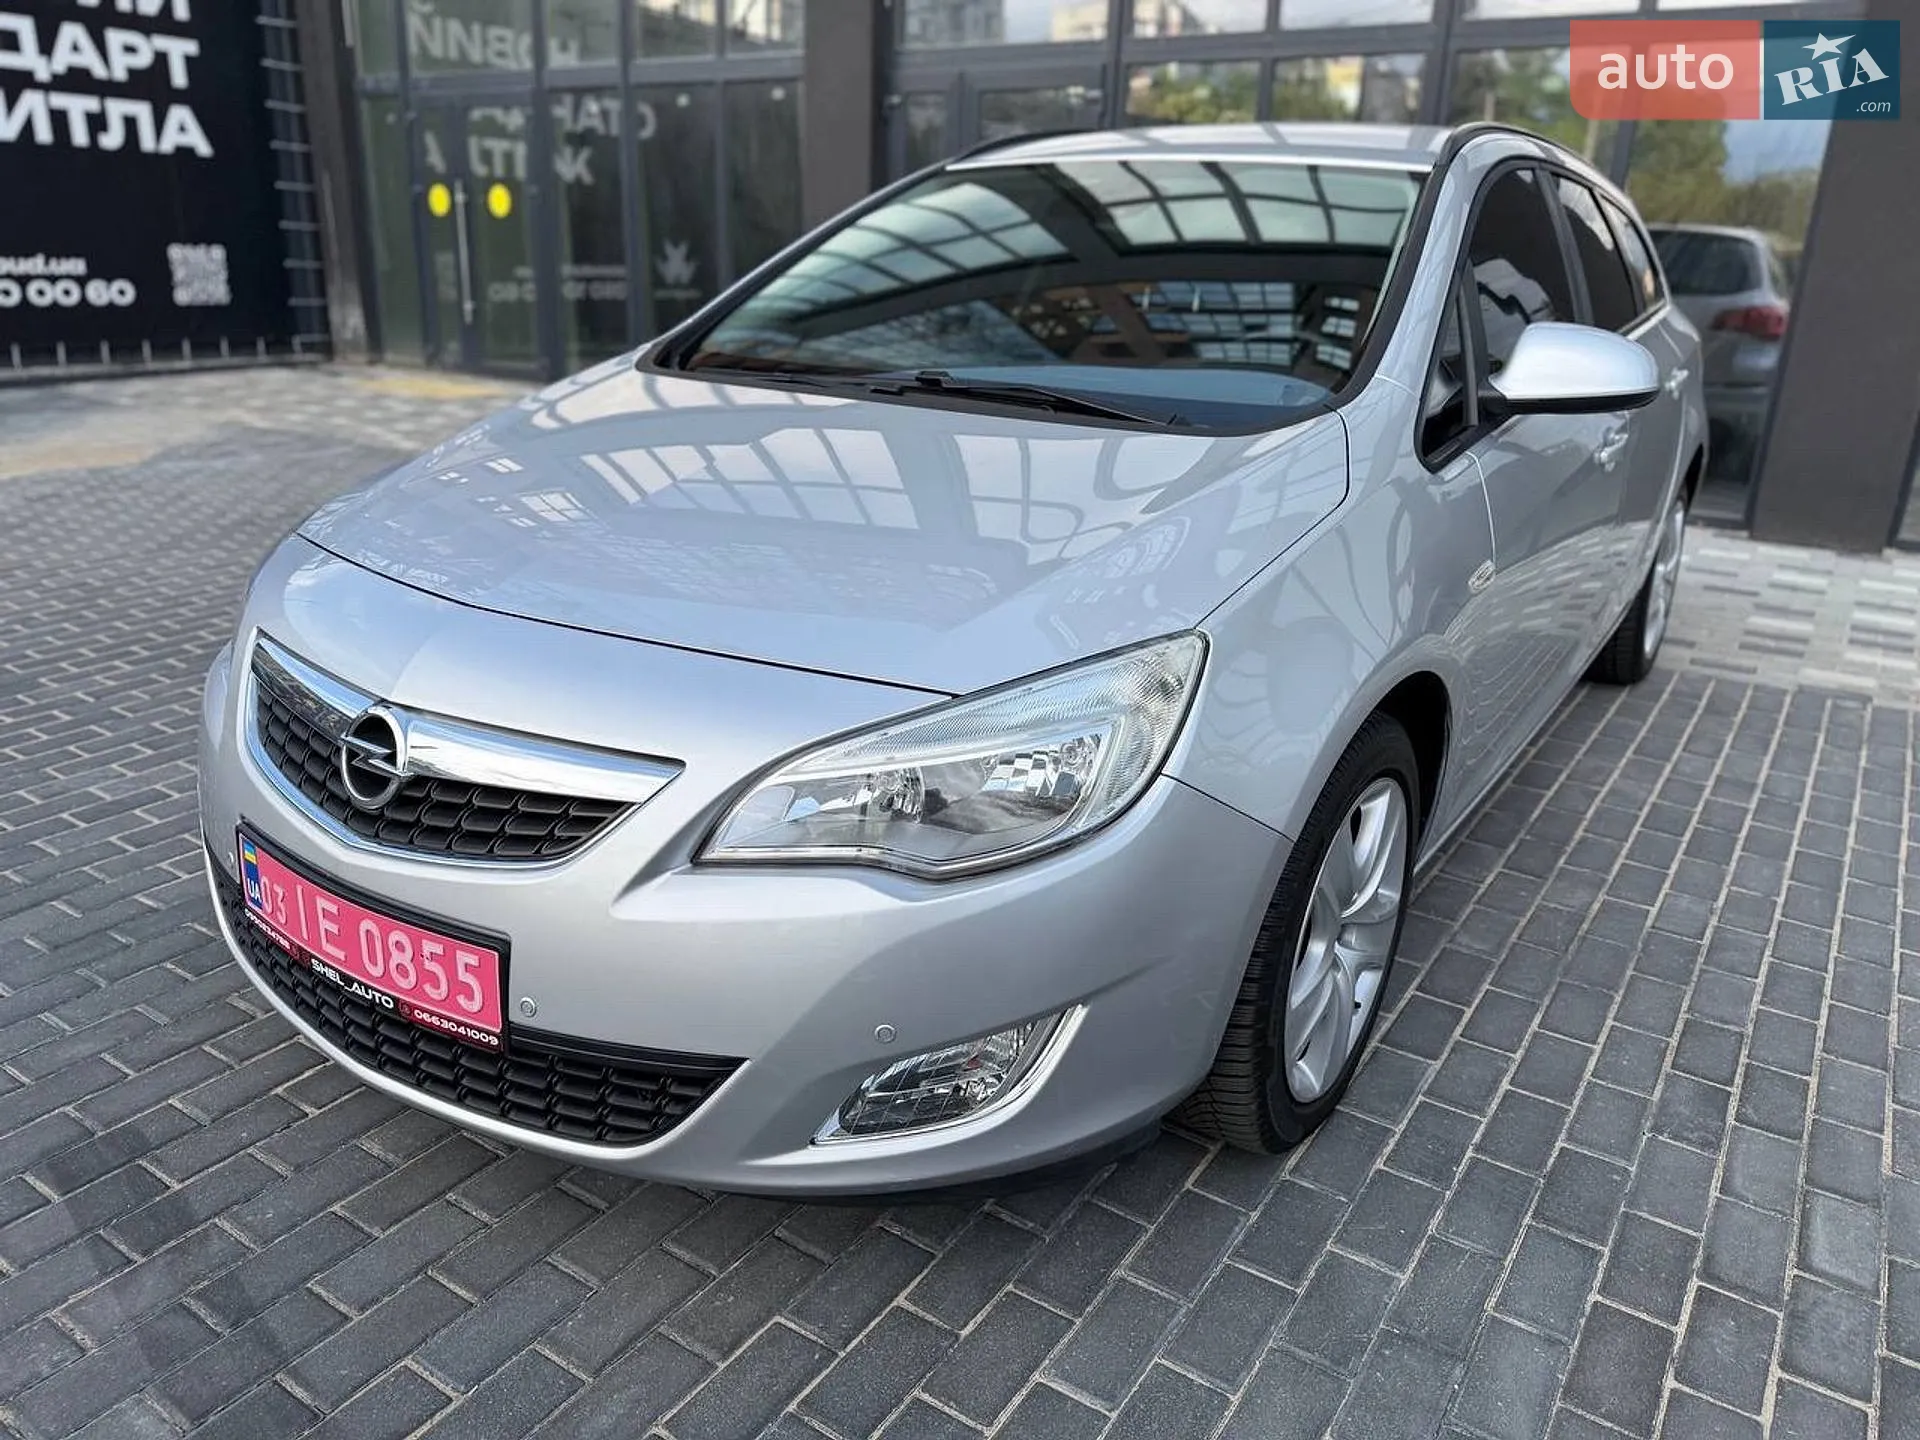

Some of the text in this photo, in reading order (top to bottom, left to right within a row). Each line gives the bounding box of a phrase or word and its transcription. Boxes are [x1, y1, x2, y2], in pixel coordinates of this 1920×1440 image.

[247, 877, 262, 902] UA
[260, 874, 287, 925] 03
[359, 918, 483, 1013] 0855
[310, 958, 394, 1009] SHEL_AUTO
